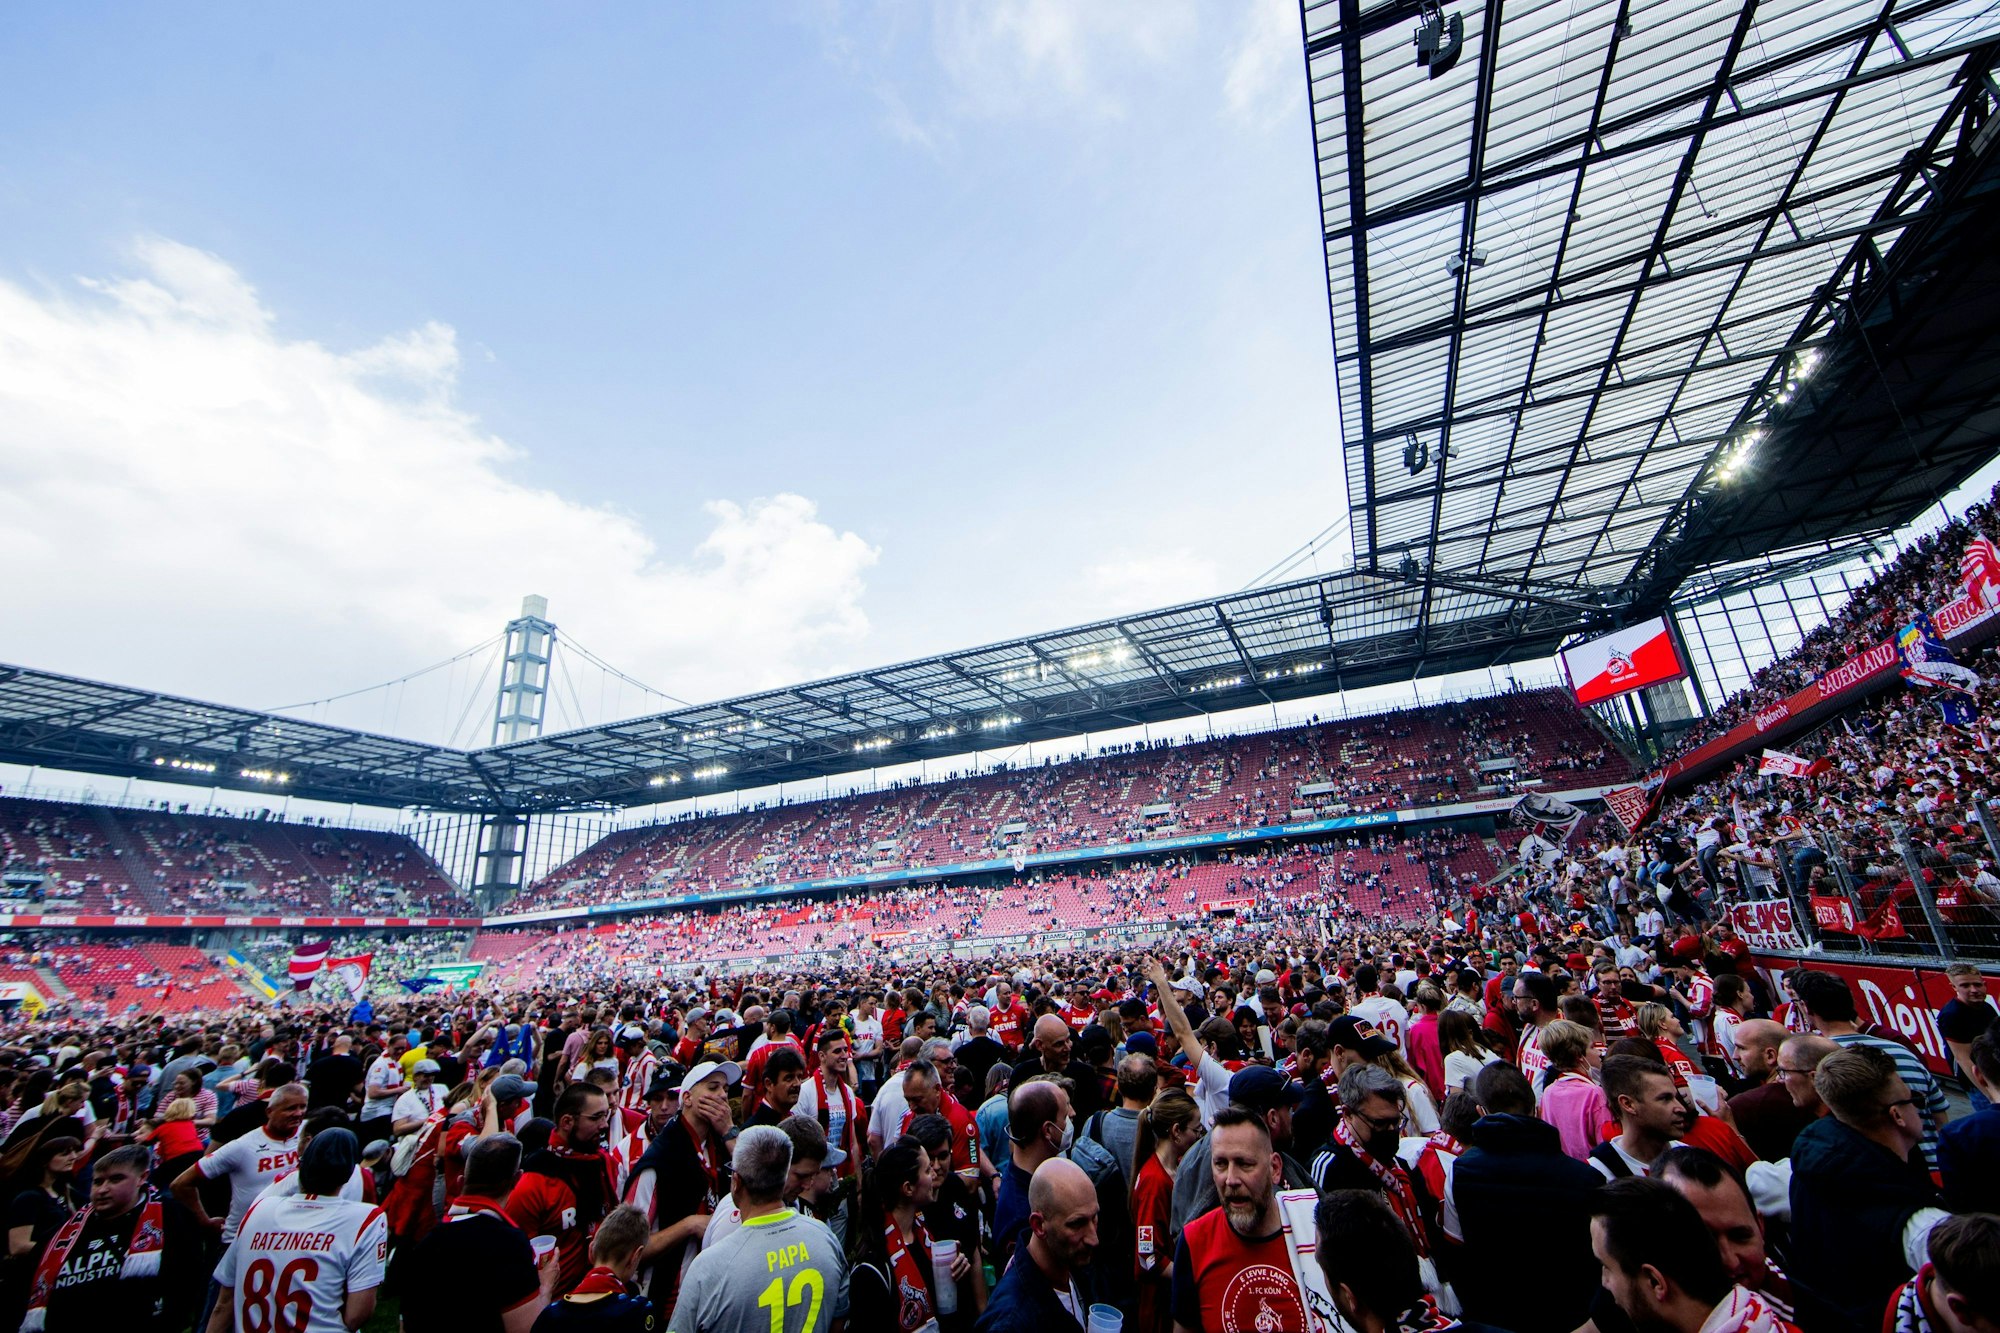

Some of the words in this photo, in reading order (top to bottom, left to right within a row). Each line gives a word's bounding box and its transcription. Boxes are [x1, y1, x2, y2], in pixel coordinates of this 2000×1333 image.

[1817, 643, 1895, 697] SAUERLAND
[1475, 801, 1517, 811] RheinEnergie
[1355, 816, 1371, 825] Spiel
[1372, 814, 1389, 823] Kiste
[1226, 832, 1241, 841] Spiel
[1241, 830, 1258, 839] Kiste
[1815, 905, 1838, 924] RED
[994, 1021, 1018, 1032] REWE
[1520, 1054, 1549, 1071] REWE
[969, 1138, 978, 1164] DEVK
[250, 1232, 335, 1252] RATZINGER
[766, 1241, 810, 1273] PAPA
[1245, 1268, 1267, 1279] LEVVE
[1269, 1270, 1289, 1286] LANG
[242, 1257, 319, 1333] 86
[1248, 1287, 1255, 1295] 1.
[1264, 1286, 1282, 1295] KÖLN
[758, 1267, 825, 1333] 12
